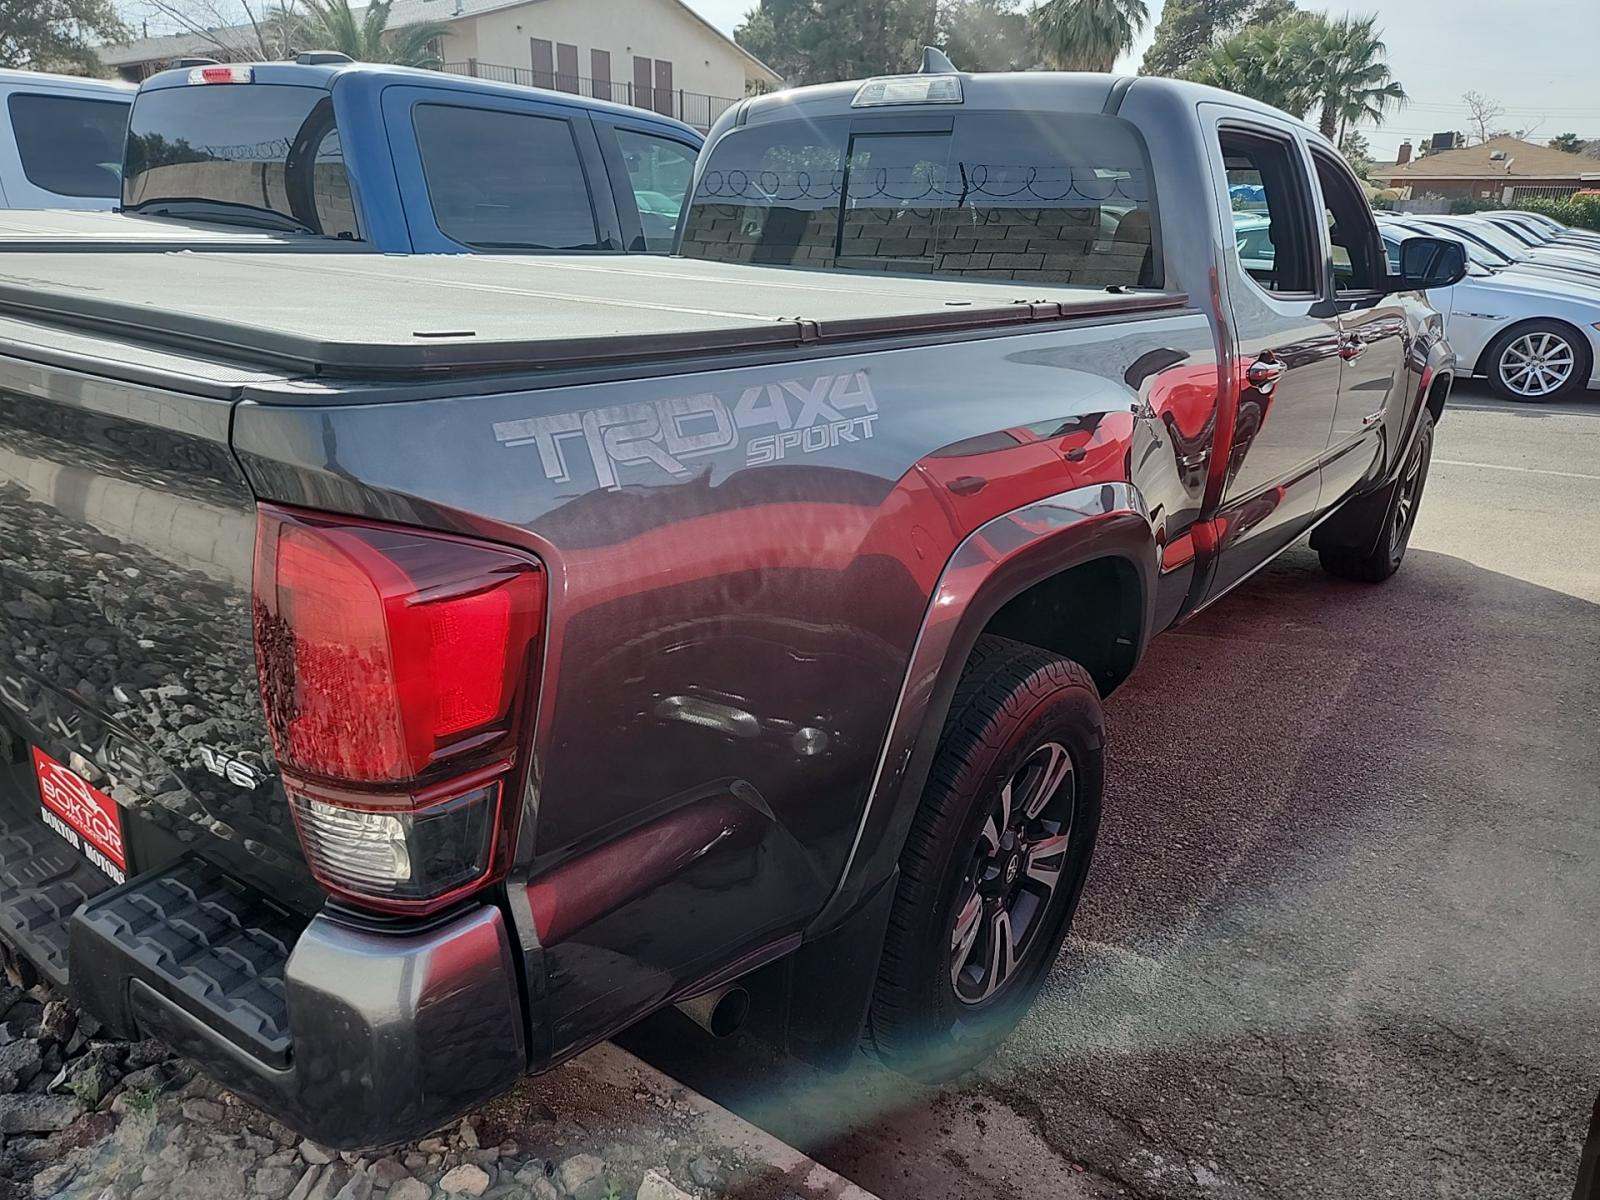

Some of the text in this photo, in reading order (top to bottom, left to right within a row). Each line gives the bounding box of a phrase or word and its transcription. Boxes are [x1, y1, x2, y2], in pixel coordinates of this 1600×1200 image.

[492, 392, 738, 491] TRD
[745, 413, 879, 467] SPORT
[200, 747, 256, 790] V6
[41, 776, 122, 854] BOKTOR
[41, 806, 126, 886] BOKTOR MOTORS
